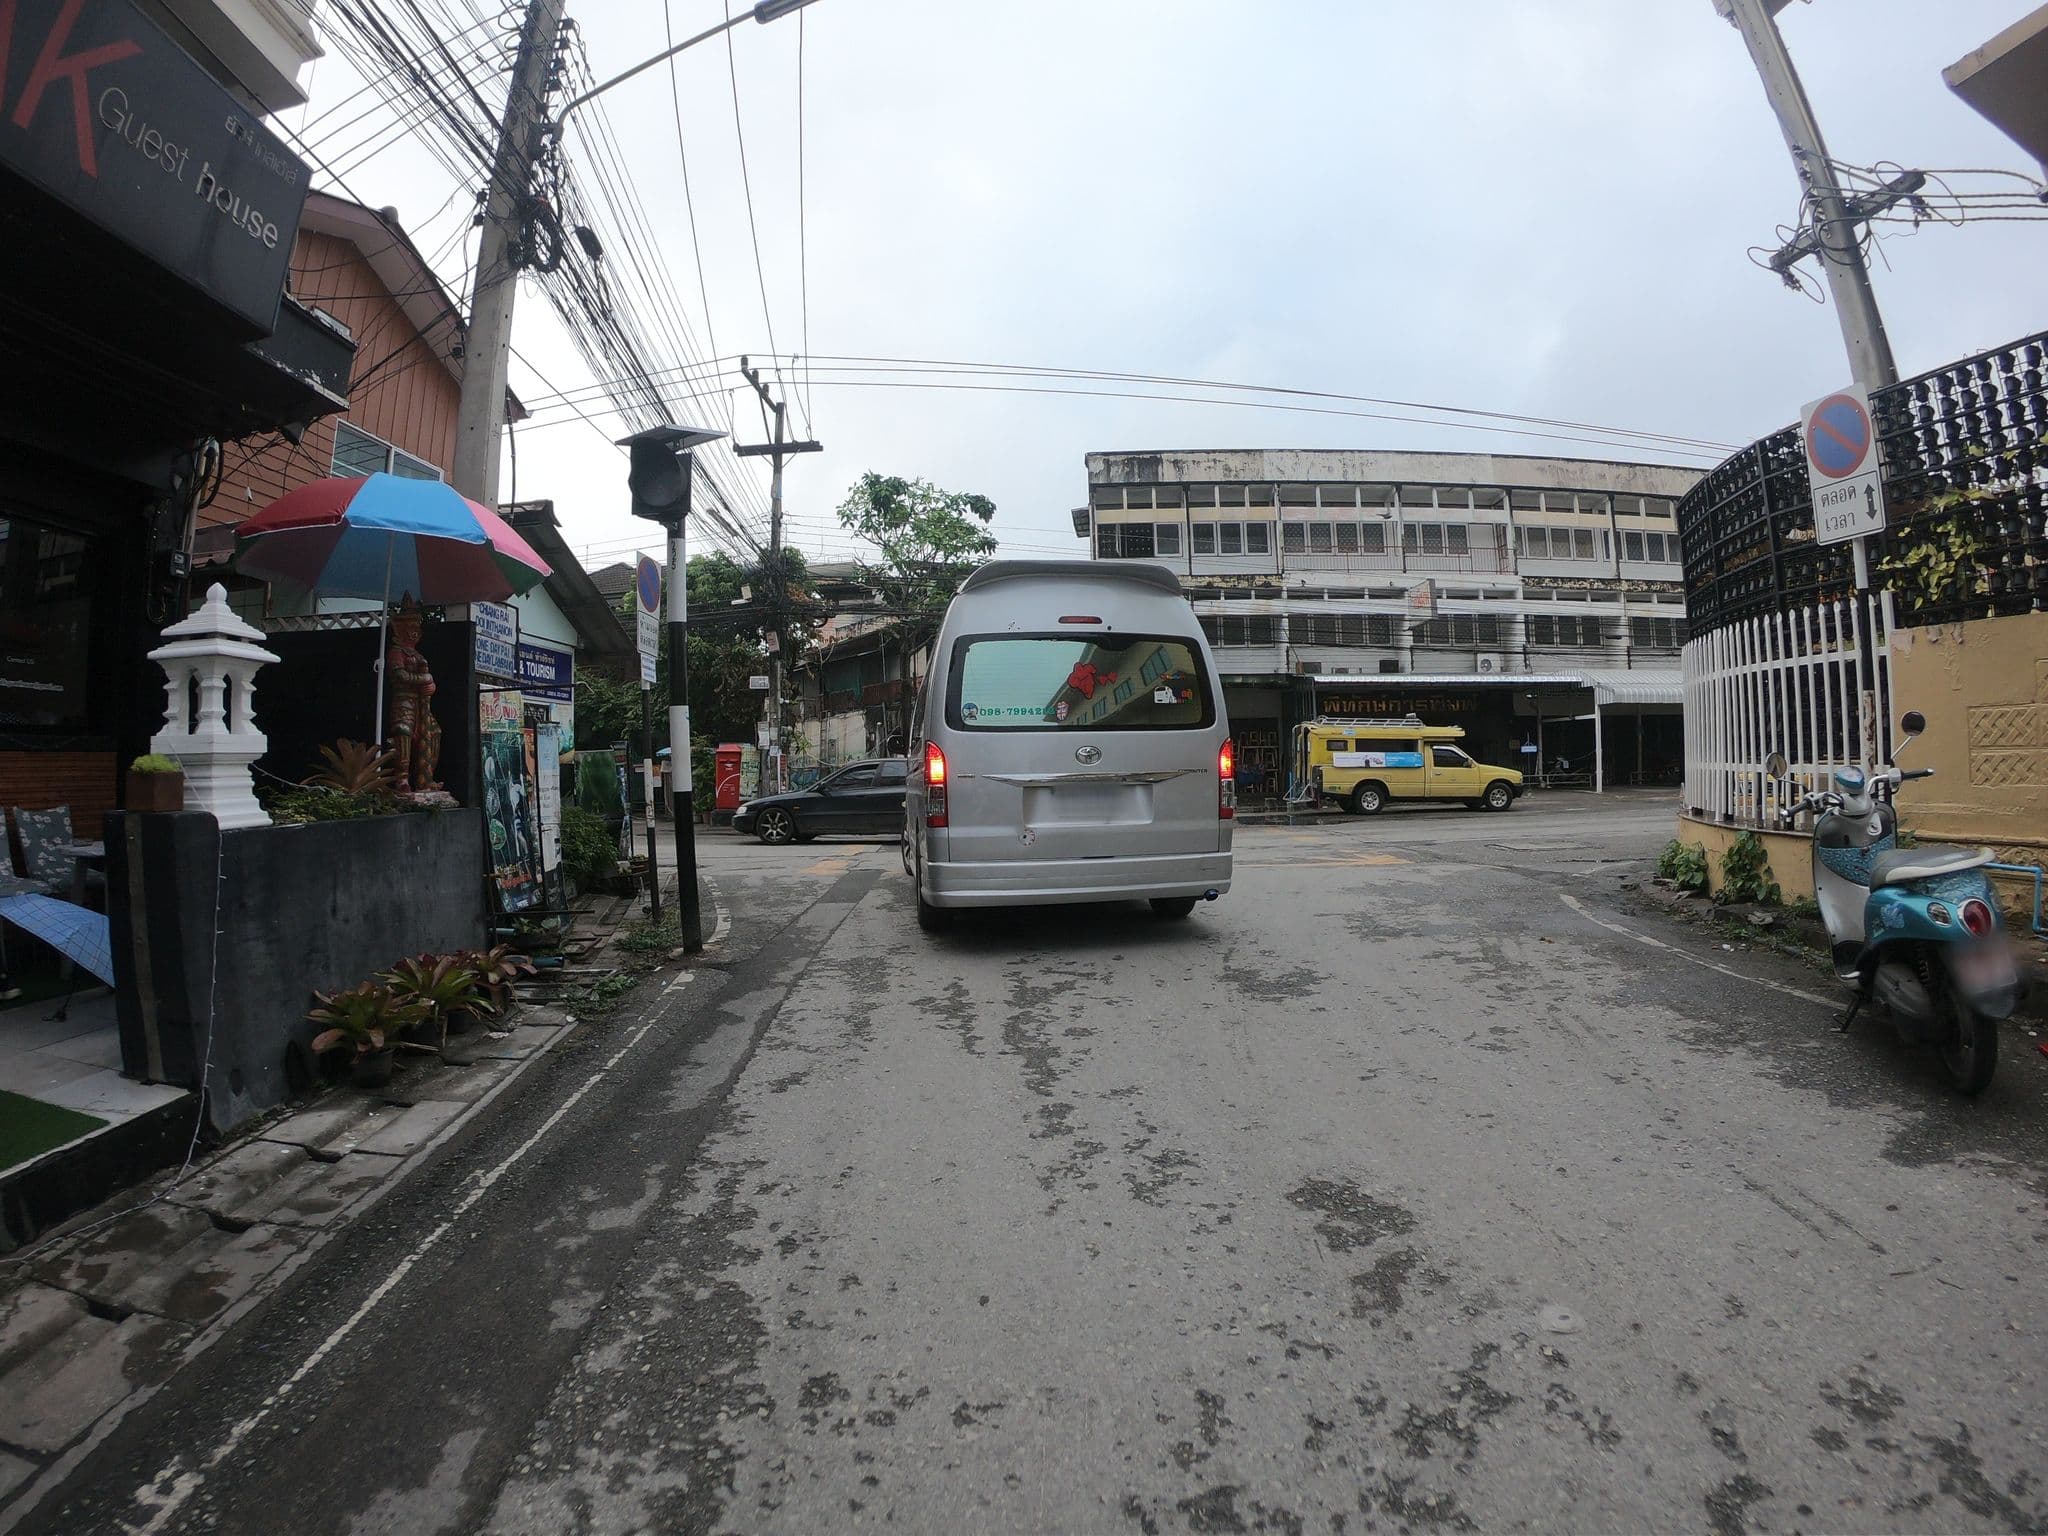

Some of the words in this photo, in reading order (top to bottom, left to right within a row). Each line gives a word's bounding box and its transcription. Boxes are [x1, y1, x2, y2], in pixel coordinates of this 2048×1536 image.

[99, 87, 190, 182] Guest
[194, 161, 279, 249] house
[1821, 485, 1856, 507] ตลอด
[1825, 512, 1856, 532] เวลา
[526, 661, 556, 680] TOURISM
